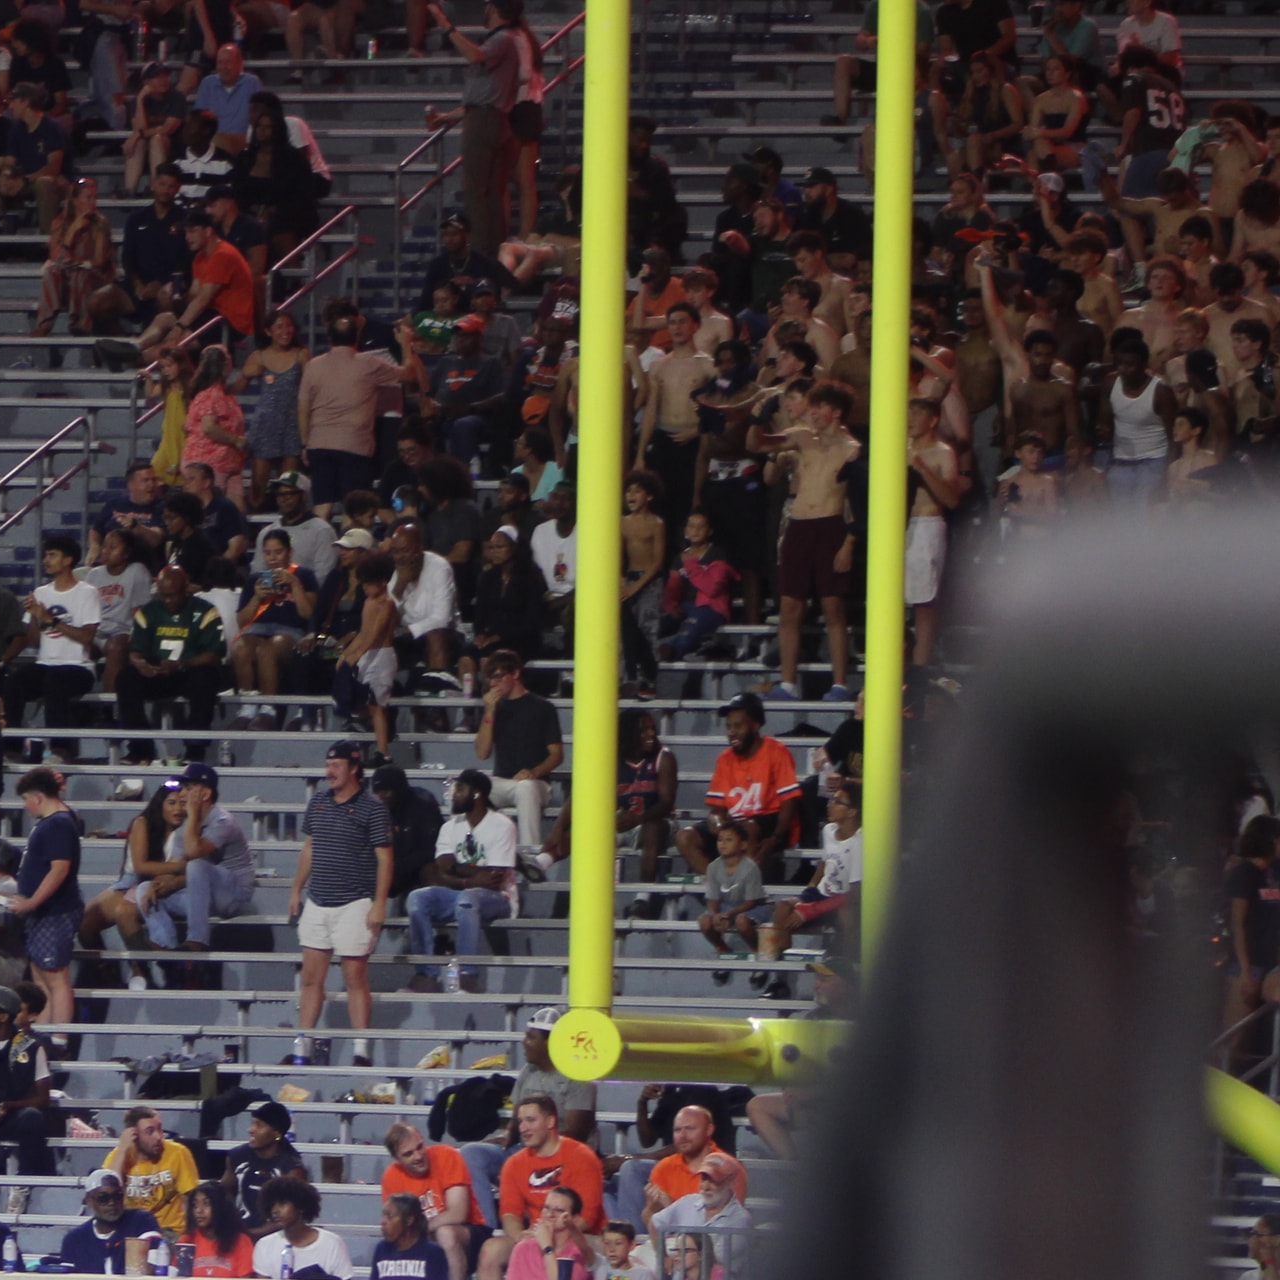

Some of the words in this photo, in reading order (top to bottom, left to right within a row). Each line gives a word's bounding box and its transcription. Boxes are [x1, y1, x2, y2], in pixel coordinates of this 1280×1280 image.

[160, 639, 184, 661] 7
[728, 783, 763, 815] 24
[376, 1259, 427, 1278] VIRGINIA
